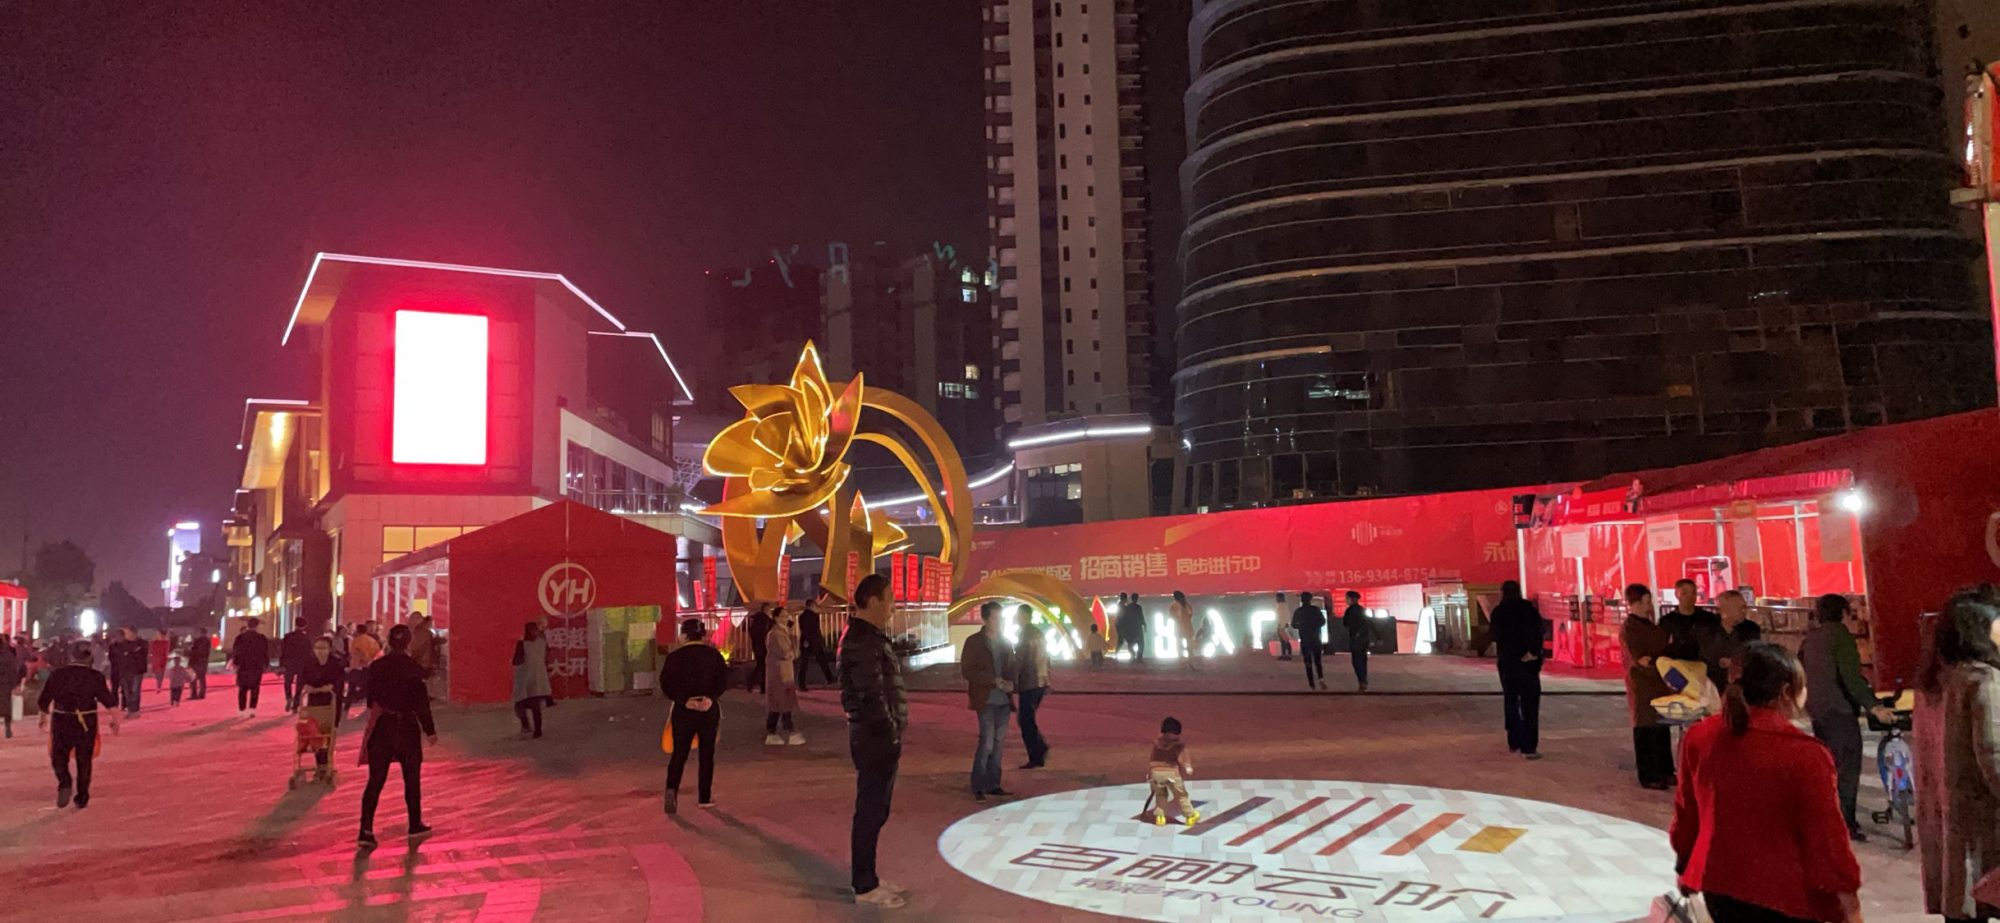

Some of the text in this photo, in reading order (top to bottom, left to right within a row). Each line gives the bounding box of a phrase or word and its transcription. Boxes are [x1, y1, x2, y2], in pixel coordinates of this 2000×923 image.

[1079, 553, 1168, 580] 招商销售
[1176, 555, 1261, 577] 同步进行中
[549, 577, 590, 606] YH
